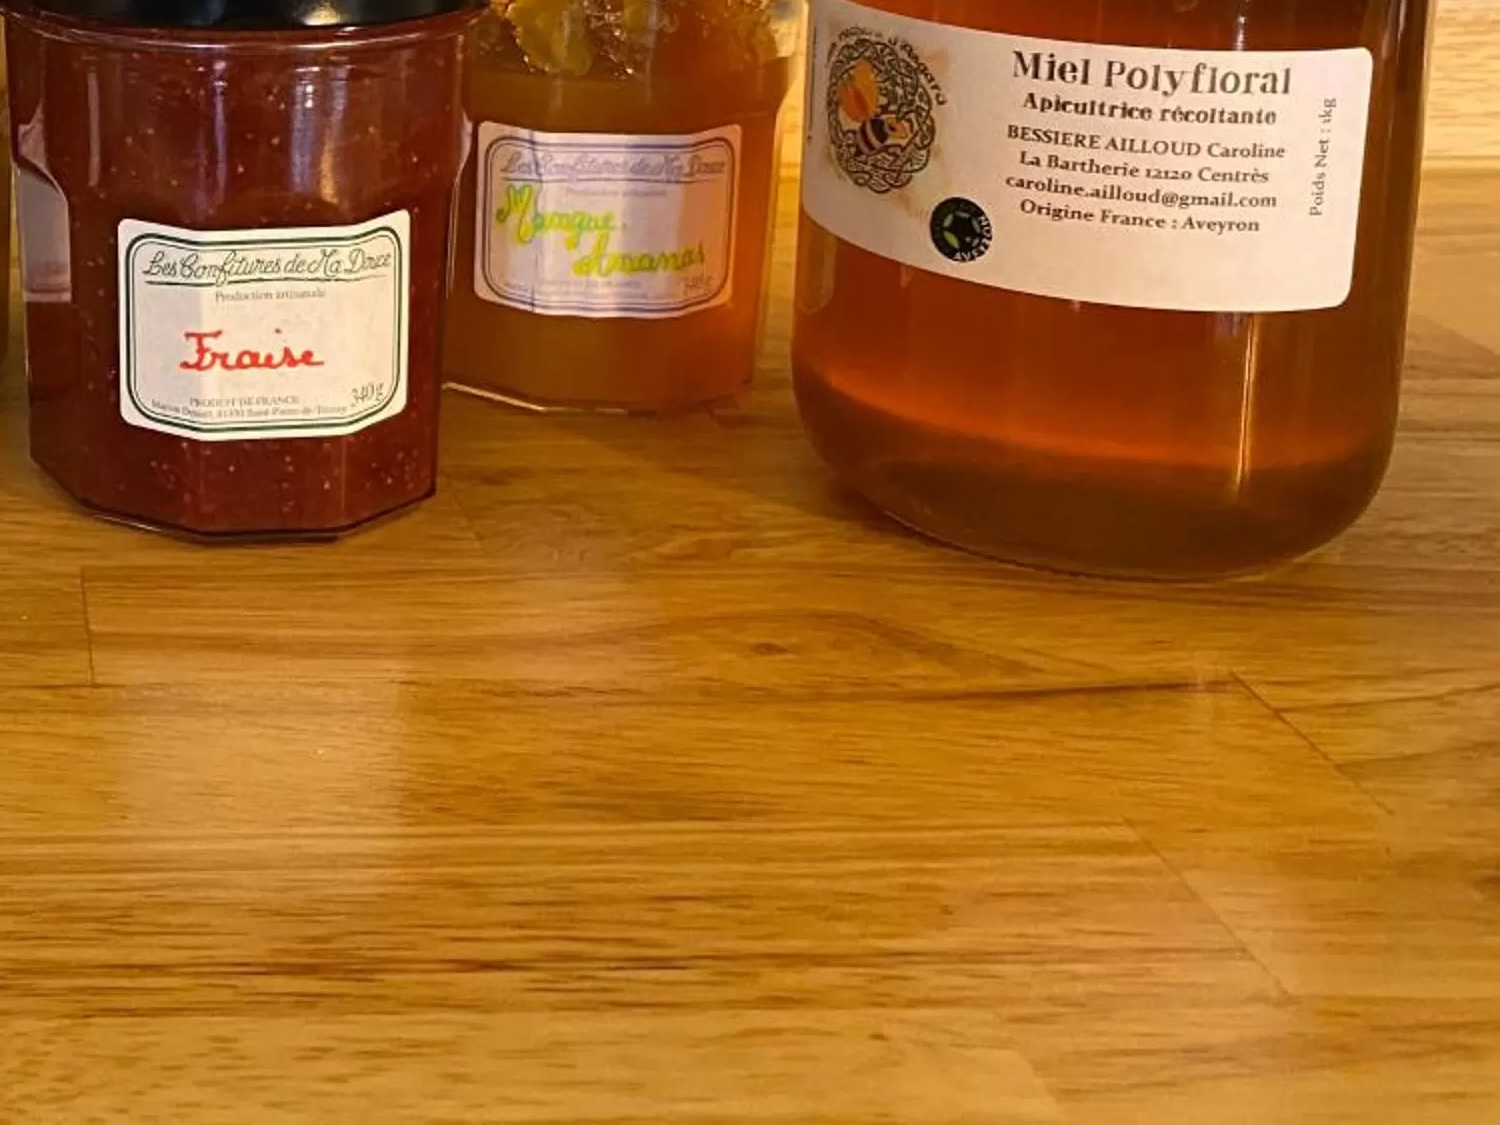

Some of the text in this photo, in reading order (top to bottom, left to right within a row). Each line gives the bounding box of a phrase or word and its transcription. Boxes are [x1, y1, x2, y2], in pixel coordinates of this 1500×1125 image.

[1012, 49, 1291, 97] Miel Polyfloral
[1023, 92, 1277, 125] Apicultrice récoltante
[1007, 124, 1286, 159] BESSIERE AILLOUD Caroline
[1314, 139, 1330, 168] Net
[1019, 150, 1269, 183] La Bartherie 12120 Centrès
[1005, 174, 1277, 209] caroline.ailloud@gmail.com
[1309, 172, 1326, 216] Poids
[496, 184, 615, 251] Mangue
[1019, 198, 1094, 223] Origine
[1101, 209, 1165, 229] France
[1181, 216, 1260, 235] Aveyron
[142, 250, 177, 276] Les
[179, 249, 281, 288] Confitures
[284, 253, 308, 274] de
[573, 232, 706, 277] Ananas
[180, 328, 325, 372] Fraise
